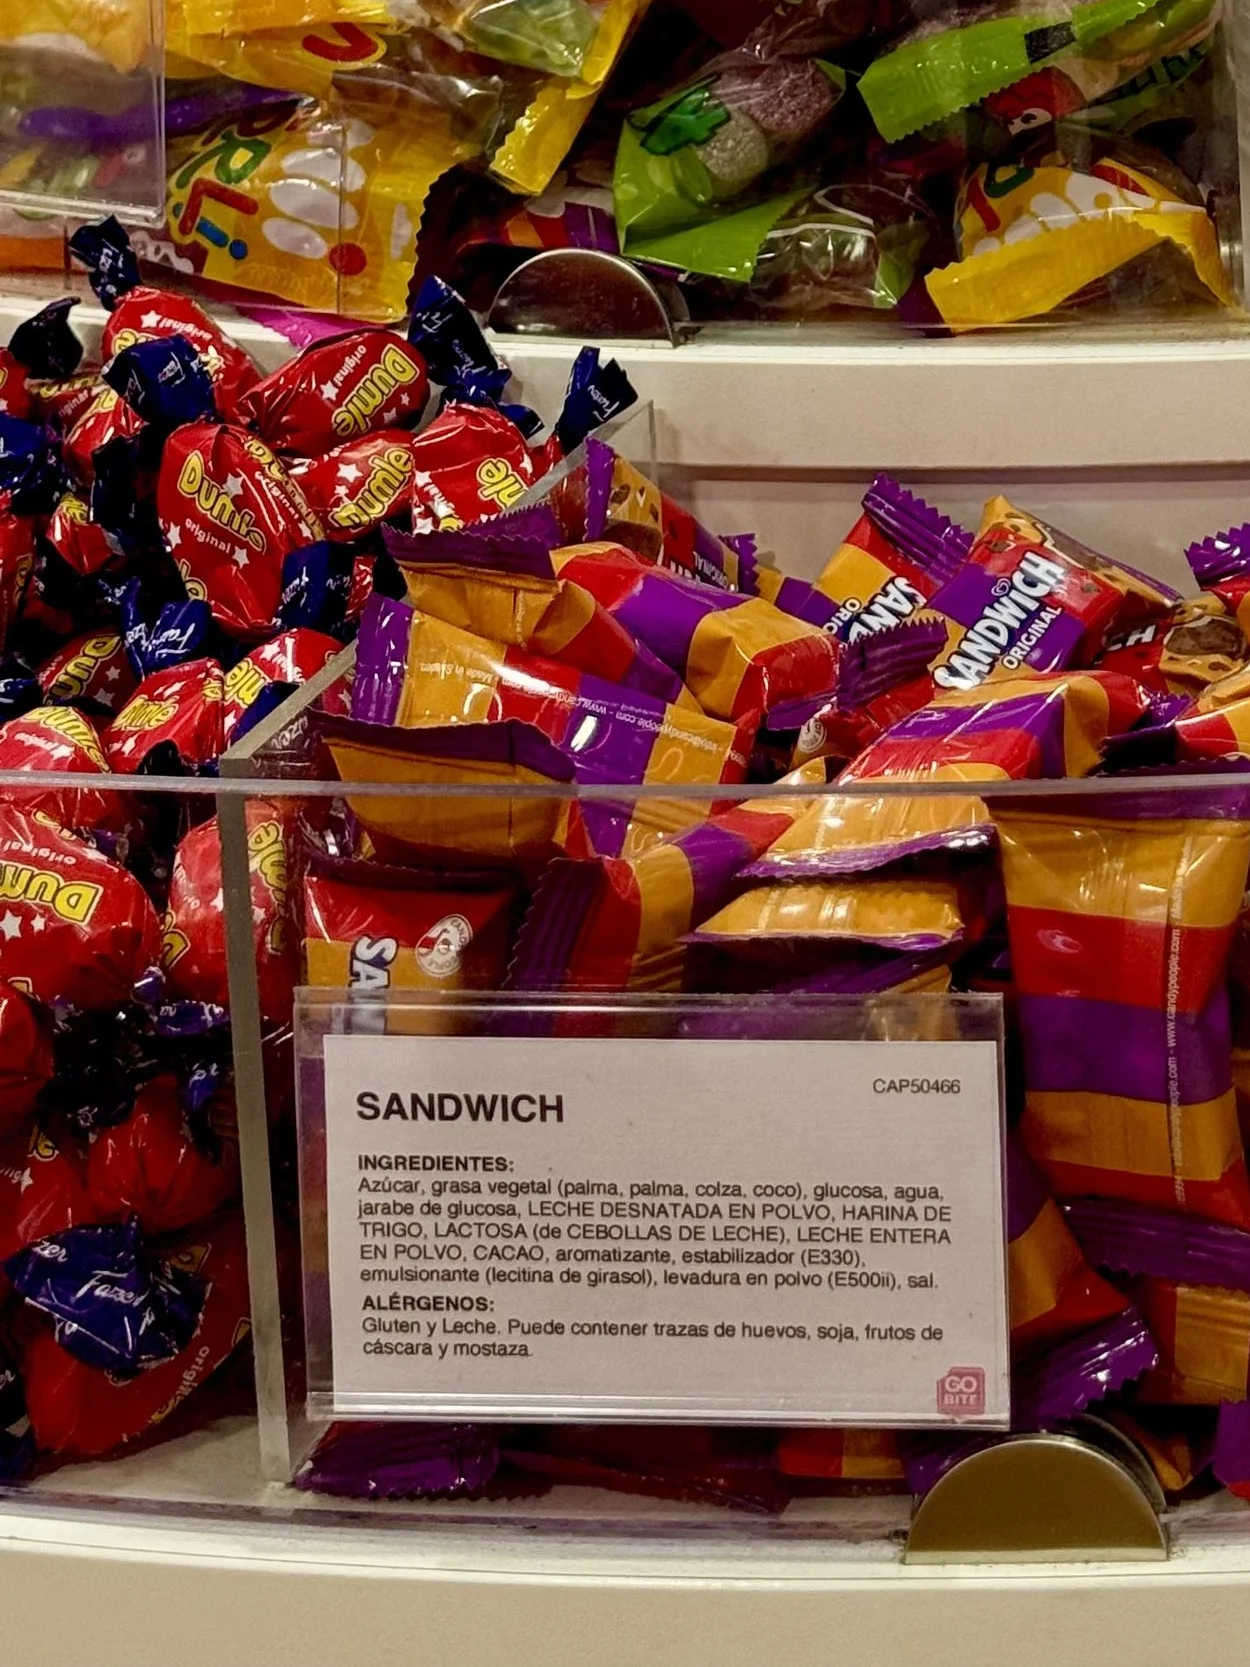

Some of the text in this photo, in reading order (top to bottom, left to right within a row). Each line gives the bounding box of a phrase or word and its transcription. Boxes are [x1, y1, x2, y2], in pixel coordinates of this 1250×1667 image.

[333, 345, 366, 389] original
[331, 344, 420, 436] Dumle
[177, 450, 267, 553] Dumle
[330, 448, 414, 530] Dumle
[185, 518, 231, 553] original
[934, 551, 1066, 690] SANDWICH
[1002, 606, 1062, 669] ORIGINAL
[873, 1078, 960, 1094] CAP50466
[357, 1091, 563, 1123] SANDWICH
[358, 1154, 514, 1173] INGREDIENTES:
[358, 1176, 943, 1203] Azúcar, grasa vegetal (palma, palma, colza, coco), glucosa, agua,
[357, 1199, 951, 1222] jarabe de glucosa, LECHE DESNATADA EN POLVO, HARINA DE
[359, 1221, 951, 1245] TRIGO, LACTOSA (de CEBOLLAS DE LECHE), LECHE ENTERA
[360, 1244, 865, 1268] EN POLVO, CACAO, aromatizante, estabilizador (E330),
[74, 1270, 150, 1307] Fazer
[360, 1266, 938, 1292] emulsionante (lecitina de girasol), levadura en polvo (E500ii), sal.
[362, 1291, 494, 1313] ALÉRGENOS:
[362, 1317, 943, 1343] Gluten y Leche. Puede contener trazas de huevos, soja, frutos de
[363, 1338, 533, 1361] cáscara y mostaza.
[945, 1376, 977, 1393] GO
